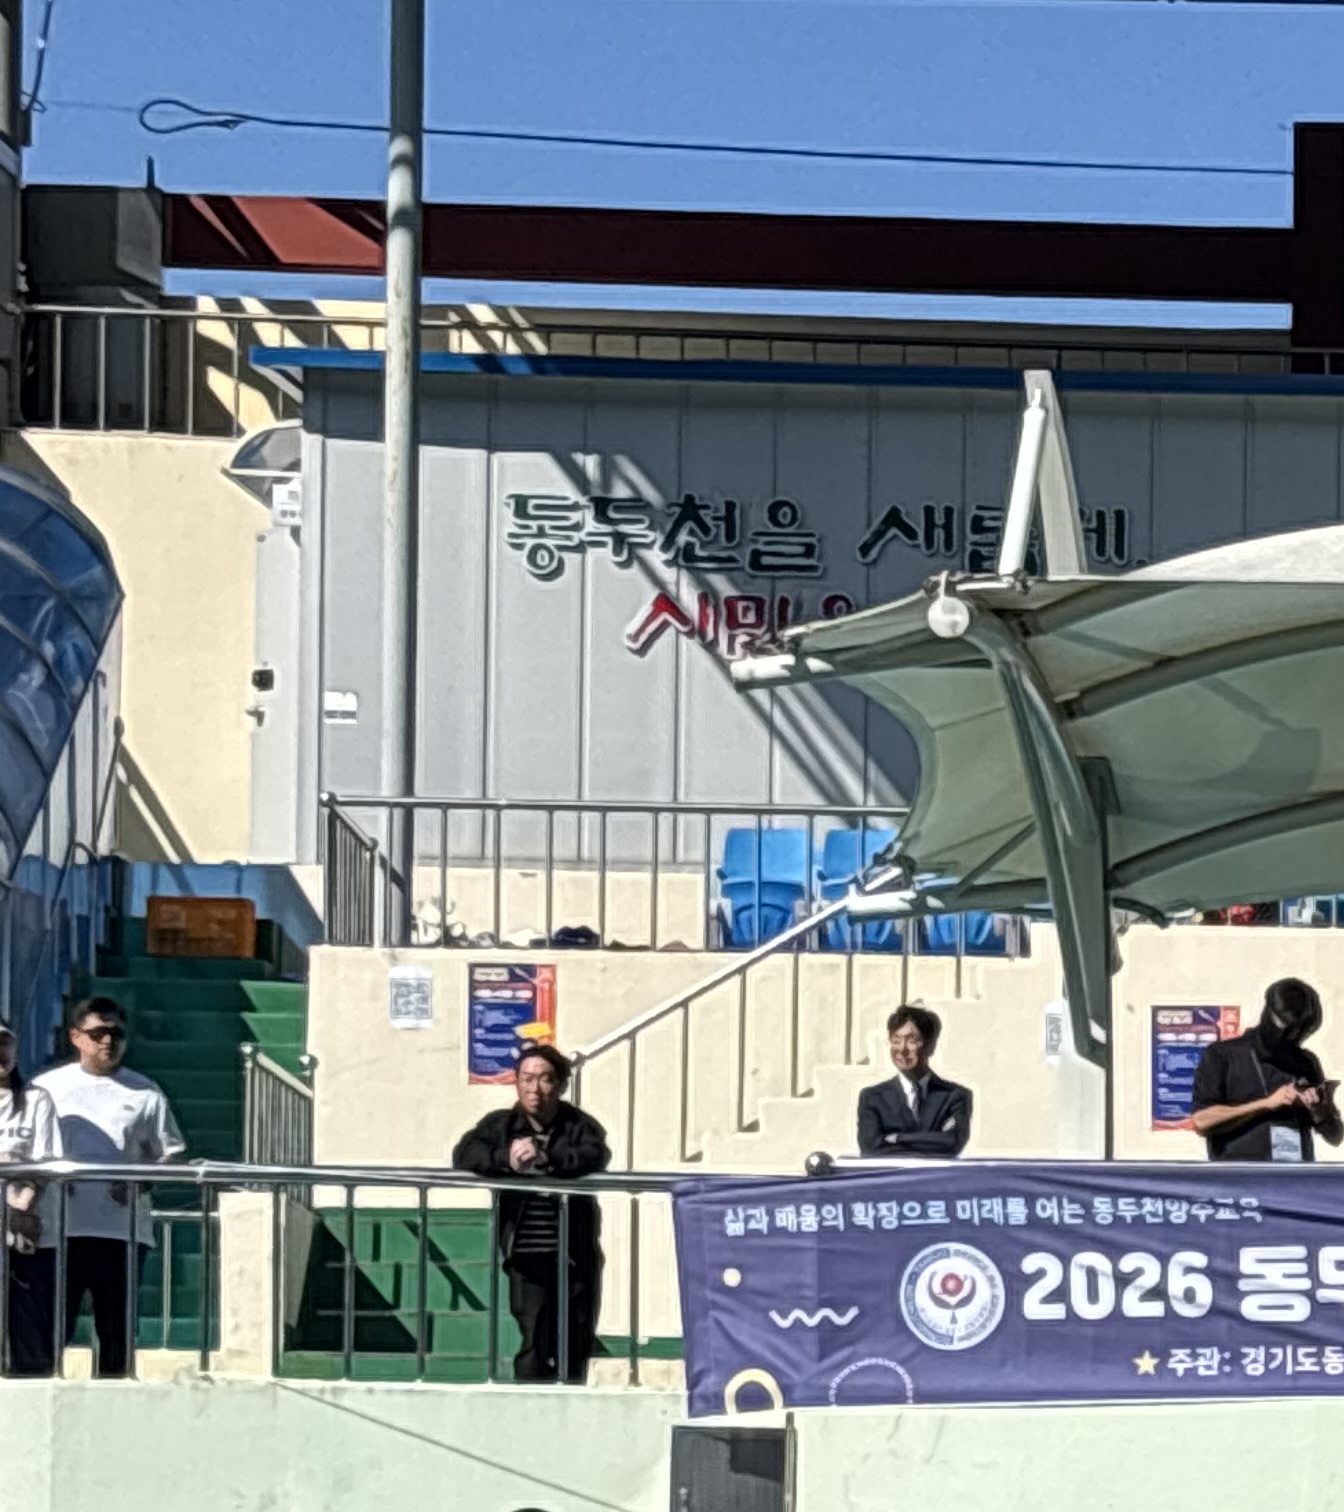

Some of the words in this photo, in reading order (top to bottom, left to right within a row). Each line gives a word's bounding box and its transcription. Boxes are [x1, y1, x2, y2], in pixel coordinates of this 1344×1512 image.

[505, 493, 823, 579] 동두천을
[724, 1206, 769, 1237] 삶과
[774, 1202, 845, 1231] 배움의
[851, 1200, 951, 1230] 확장으로
[955, 1196, 1028, 1226] 미래를
[1035, 1196, 1085, 1224] 여는
[1091, 1195, 1263, 1225] 동두천양주교육
[1021, 1251, 1213, 1320] 2026
[1167, 1346, 1231, 1377] 주관:
